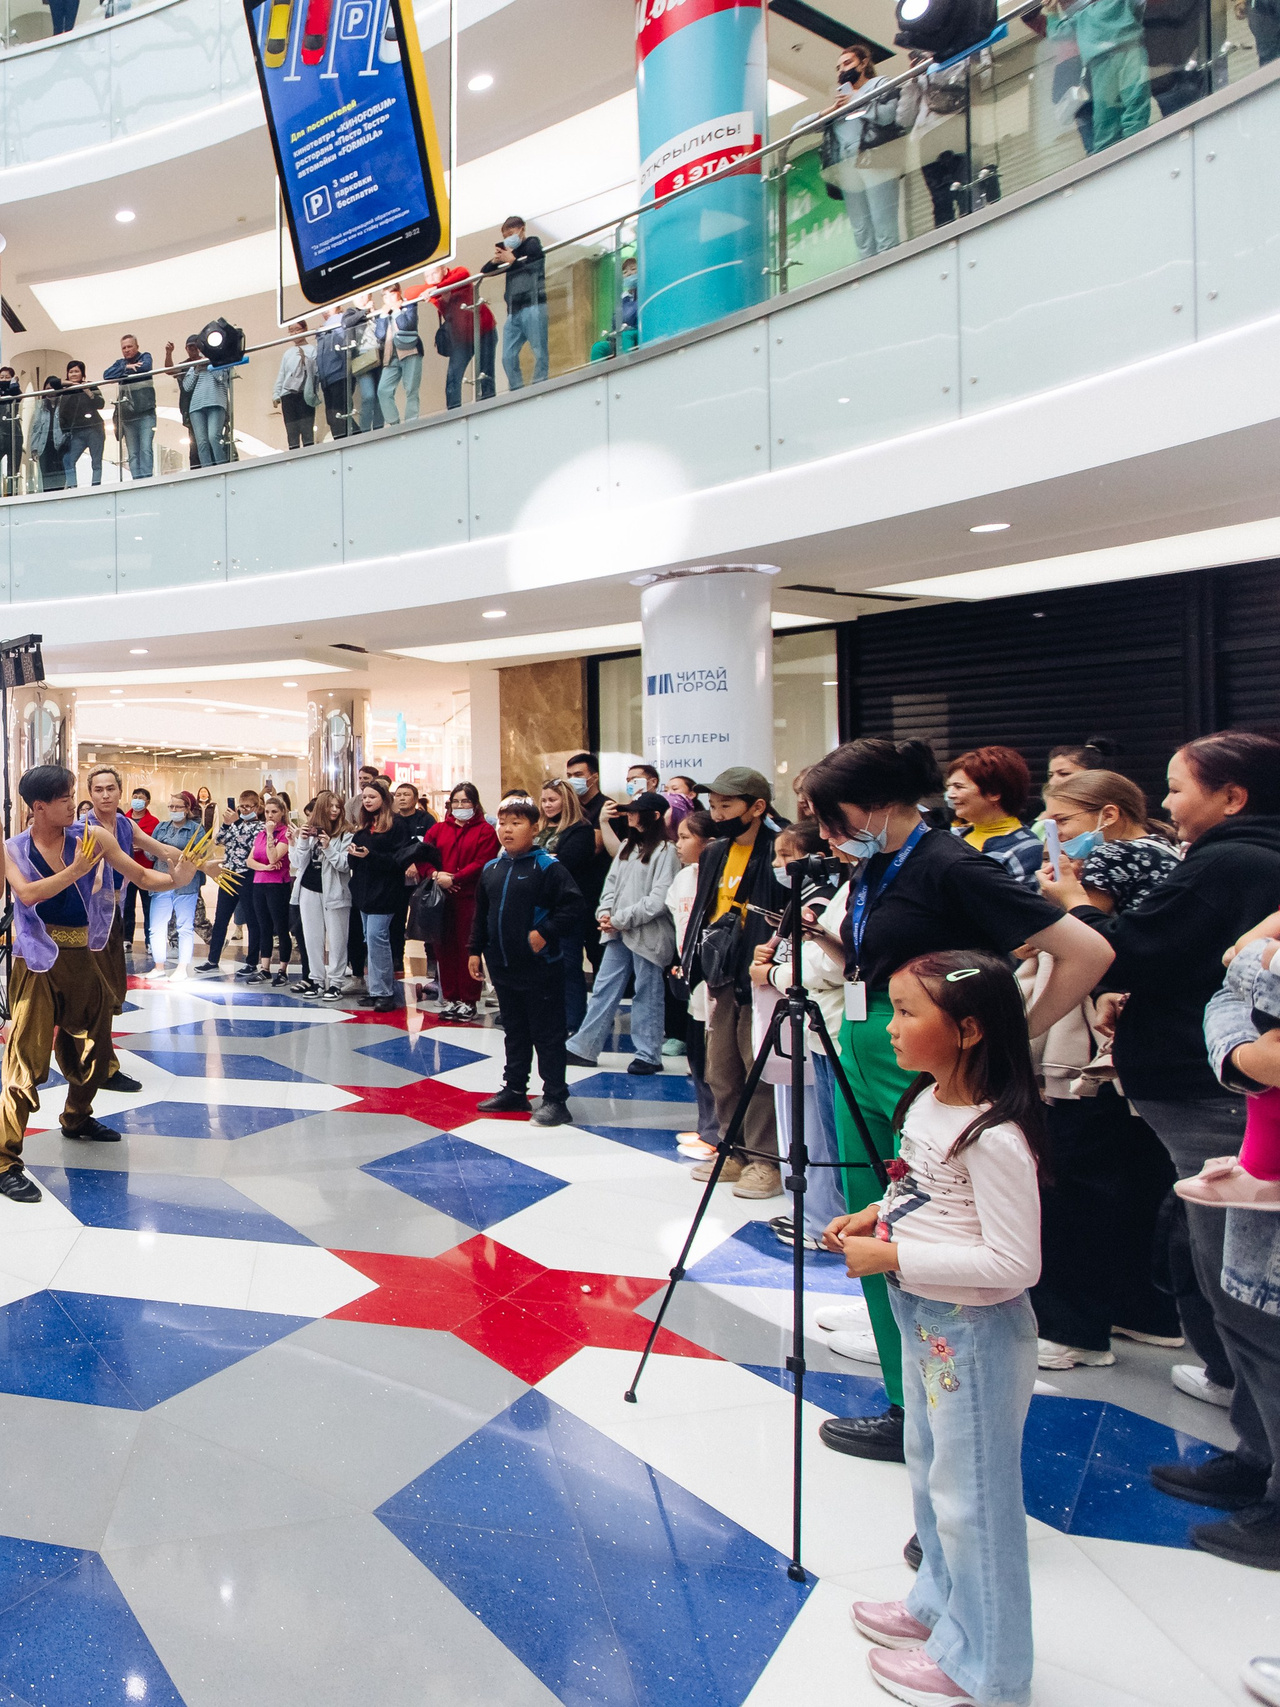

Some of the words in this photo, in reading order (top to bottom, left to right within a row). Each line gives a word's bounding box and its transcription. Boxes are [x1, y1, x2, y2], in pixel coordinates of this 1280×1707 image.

[290, 129, 306, 144] Для
[293, 129, 336, 158] кинотеатра
[336, 97, 397, 134] «КИНОFORUM»
[295, 143, 334, 170] ресторана
[334, 128, 362, 147] «Песто
[362, 113, 390, 132] Тесто»
[297, 153, 337, 179] автомойки
[337, 129, 384, 157] «FORMULA»
[332, 179, 339, 188] 3
[339, 170, 359, 183] часа
[334, 175, 373, 199] парковки
[672, 173, 685, 190] 3
[336, 184, 379, 209] бесплатно
[676, 666, 727, 681] ЧИТАЙ
[677, 680, 729, 693] ГОРОД
[647, 733, 730, 746] БЕТСЕЛЛЕРЫ
[893, 845, 913, 867] Colliers
[856, 885, 868, 906] Colliers
